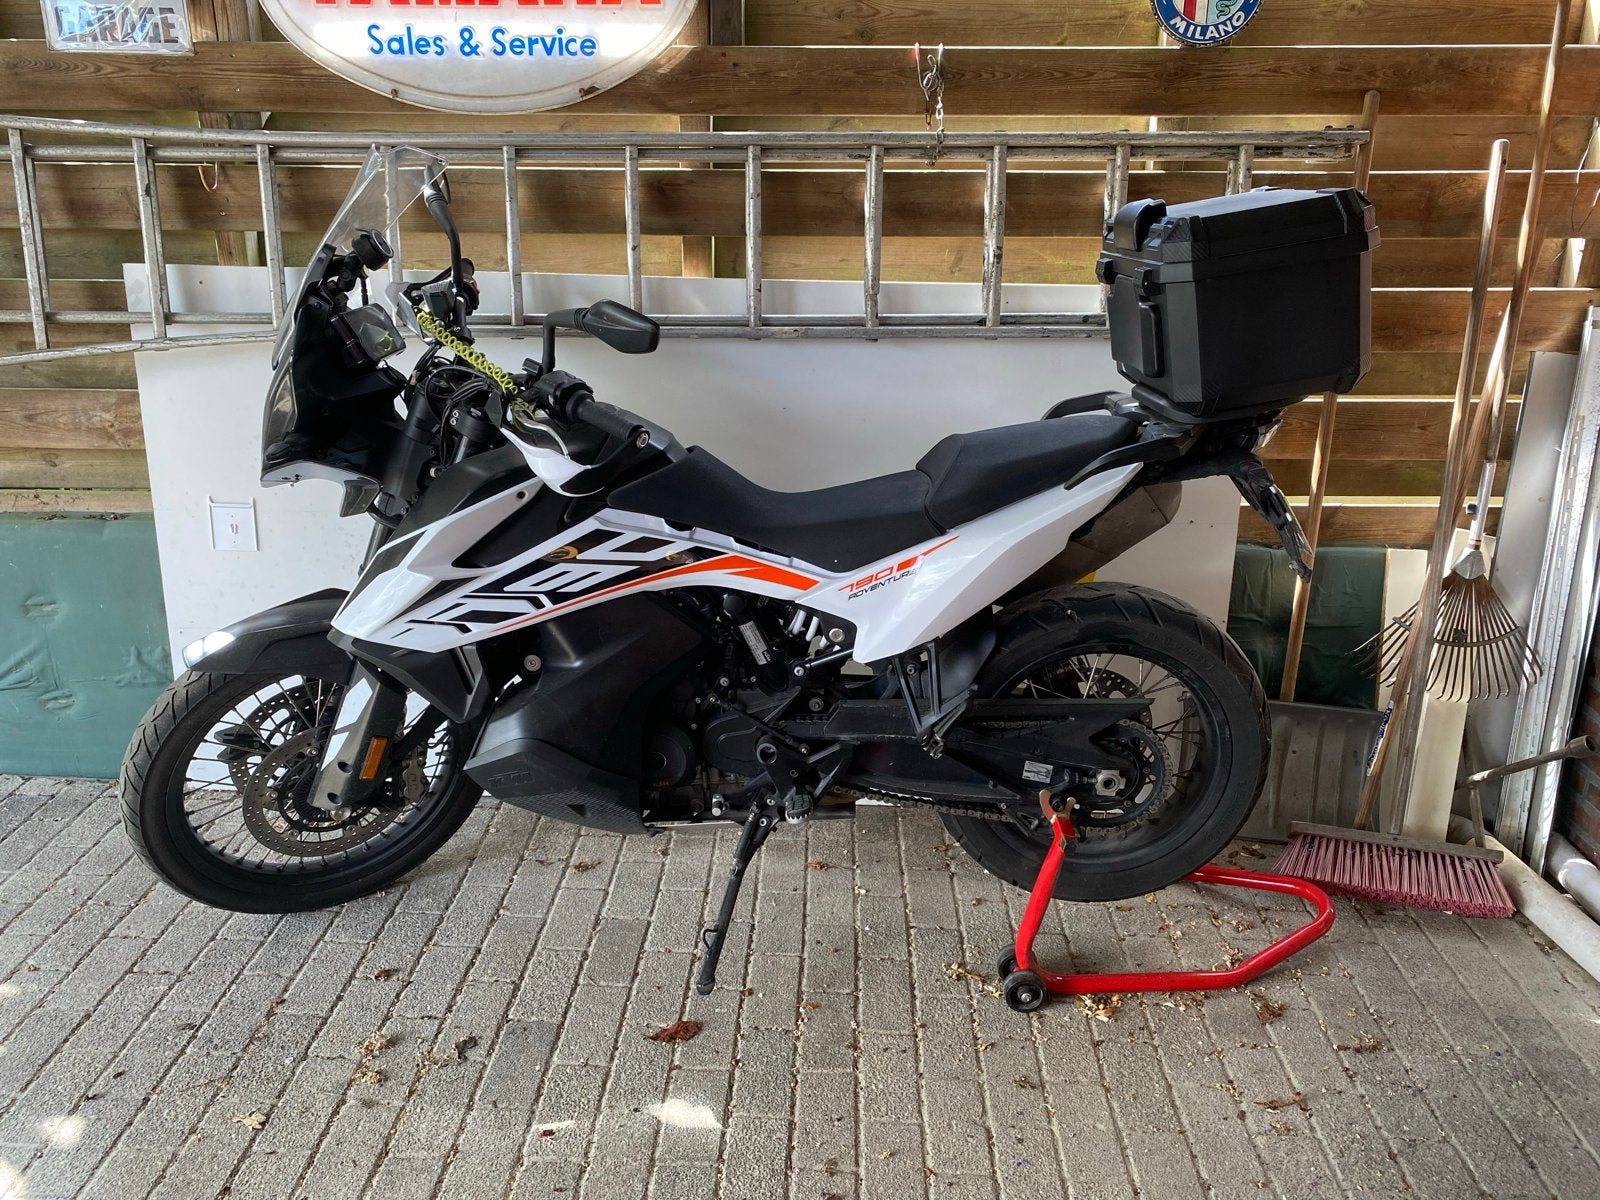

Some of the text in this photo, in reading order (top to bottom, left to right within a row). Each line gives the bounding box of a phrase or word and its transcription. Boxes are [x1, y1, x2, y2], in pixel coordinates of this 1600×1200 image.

[366, 23, 598, 57] Sales & Service
[1169, 11, 1246, 40] MILANO
[837, 566, 894, 593] 790
